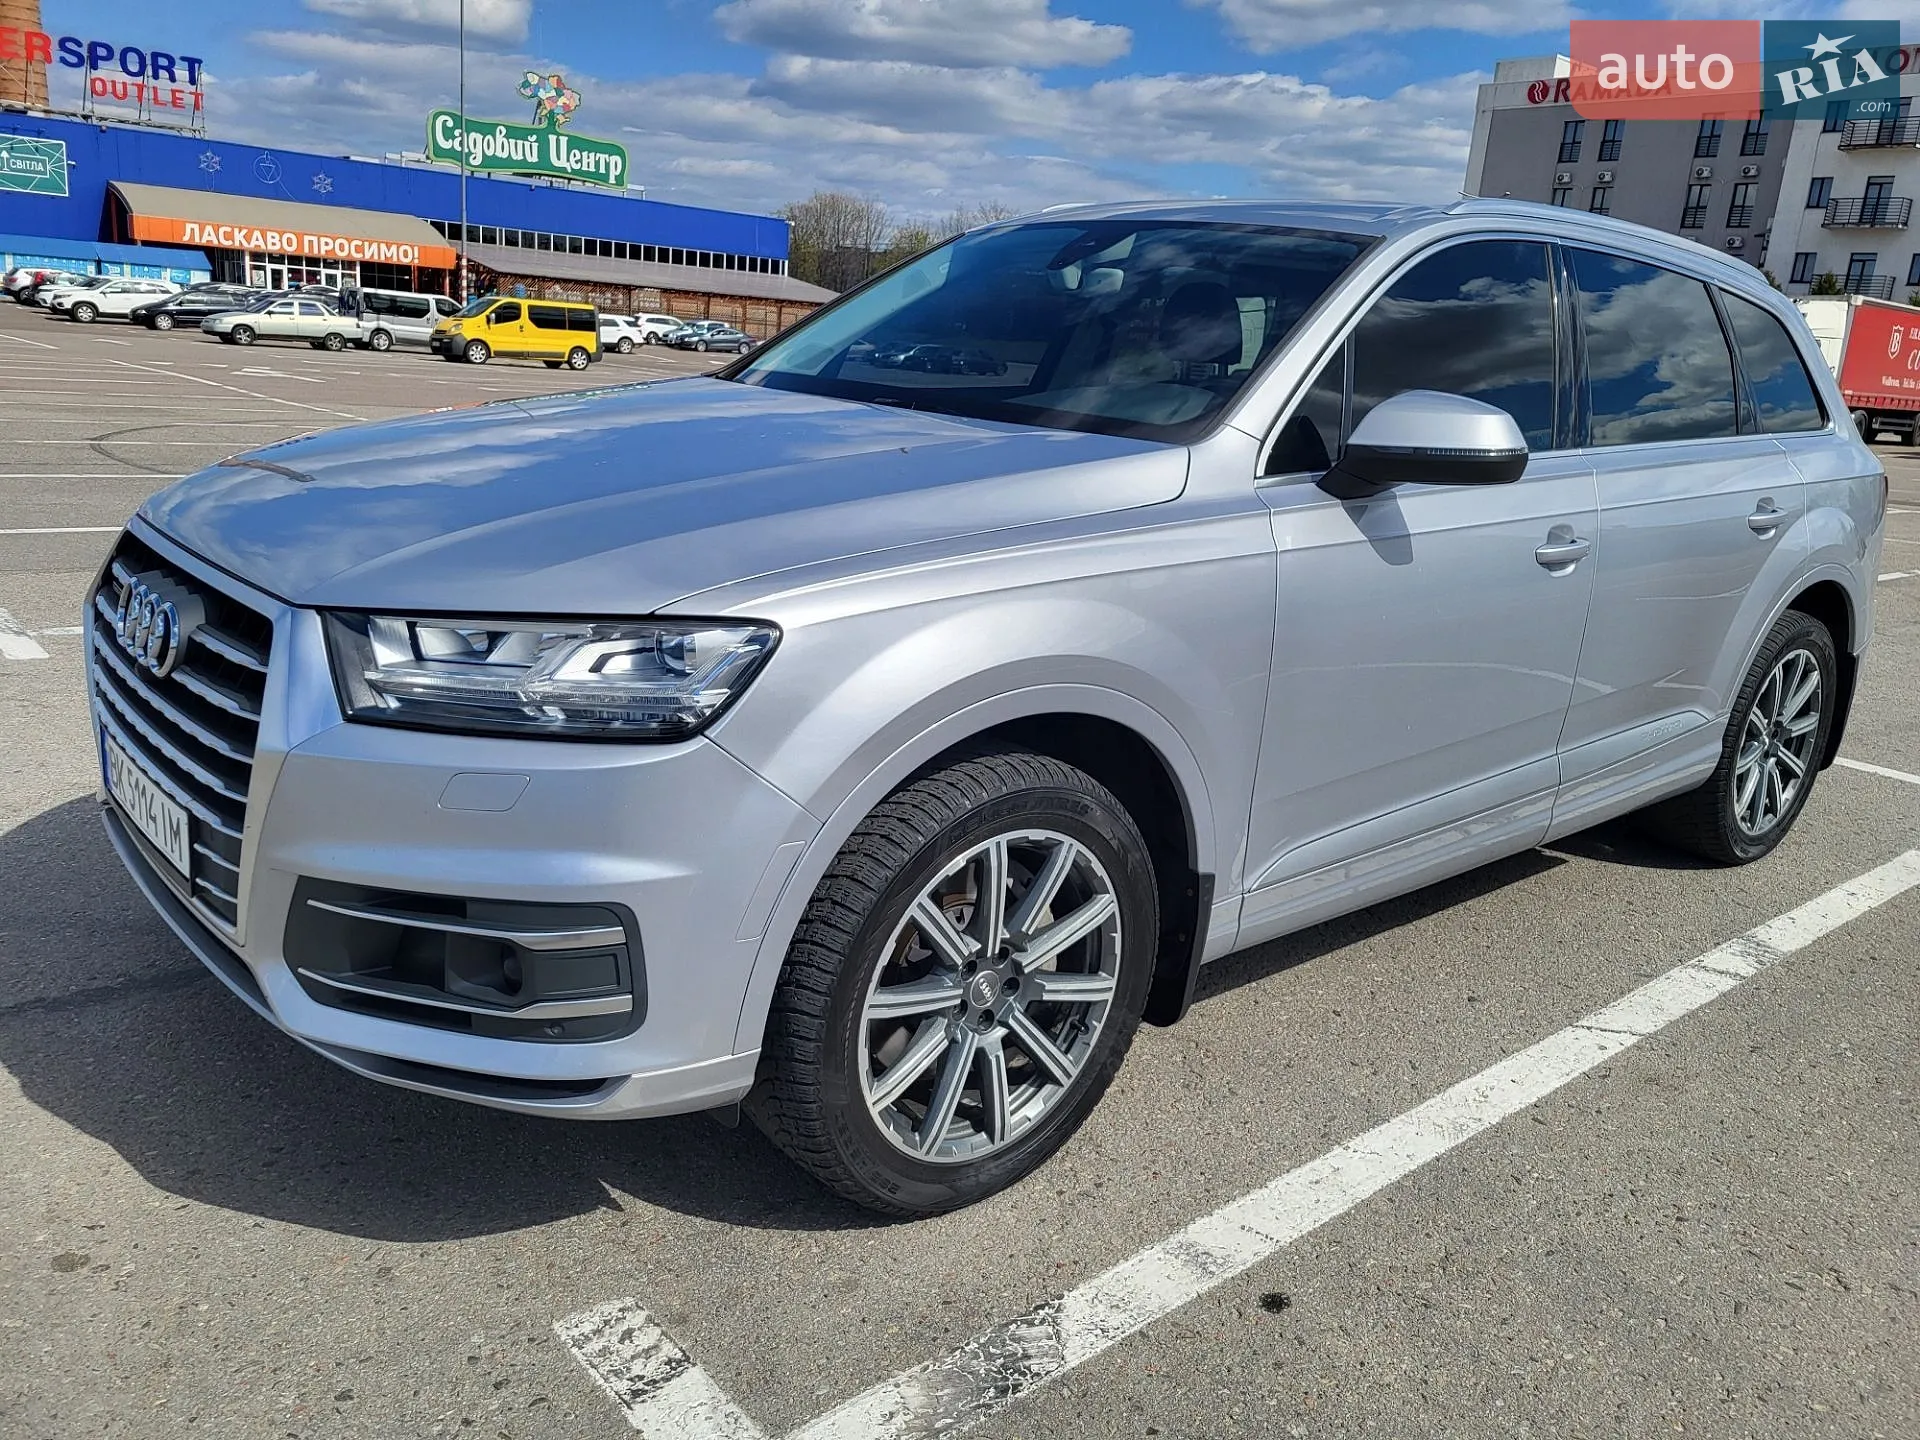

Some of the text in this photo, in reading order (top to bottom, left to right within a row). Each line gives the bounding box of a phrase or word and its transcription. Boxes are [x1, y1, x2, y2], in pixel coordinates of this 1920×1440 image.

[91, 77, 204, 111] OUTLET
[1554, 77, 1672, 103] RAMADA
[10, 159, 44, 172] СВІТЛА
[435, 115, 622, 184] Садовий Центр
[183, 223, 419, 263] ЛАСКАВО ПРОСИМО!
[127, 766, 158, 838] 5114
[161, 801, 183, 863] IM
